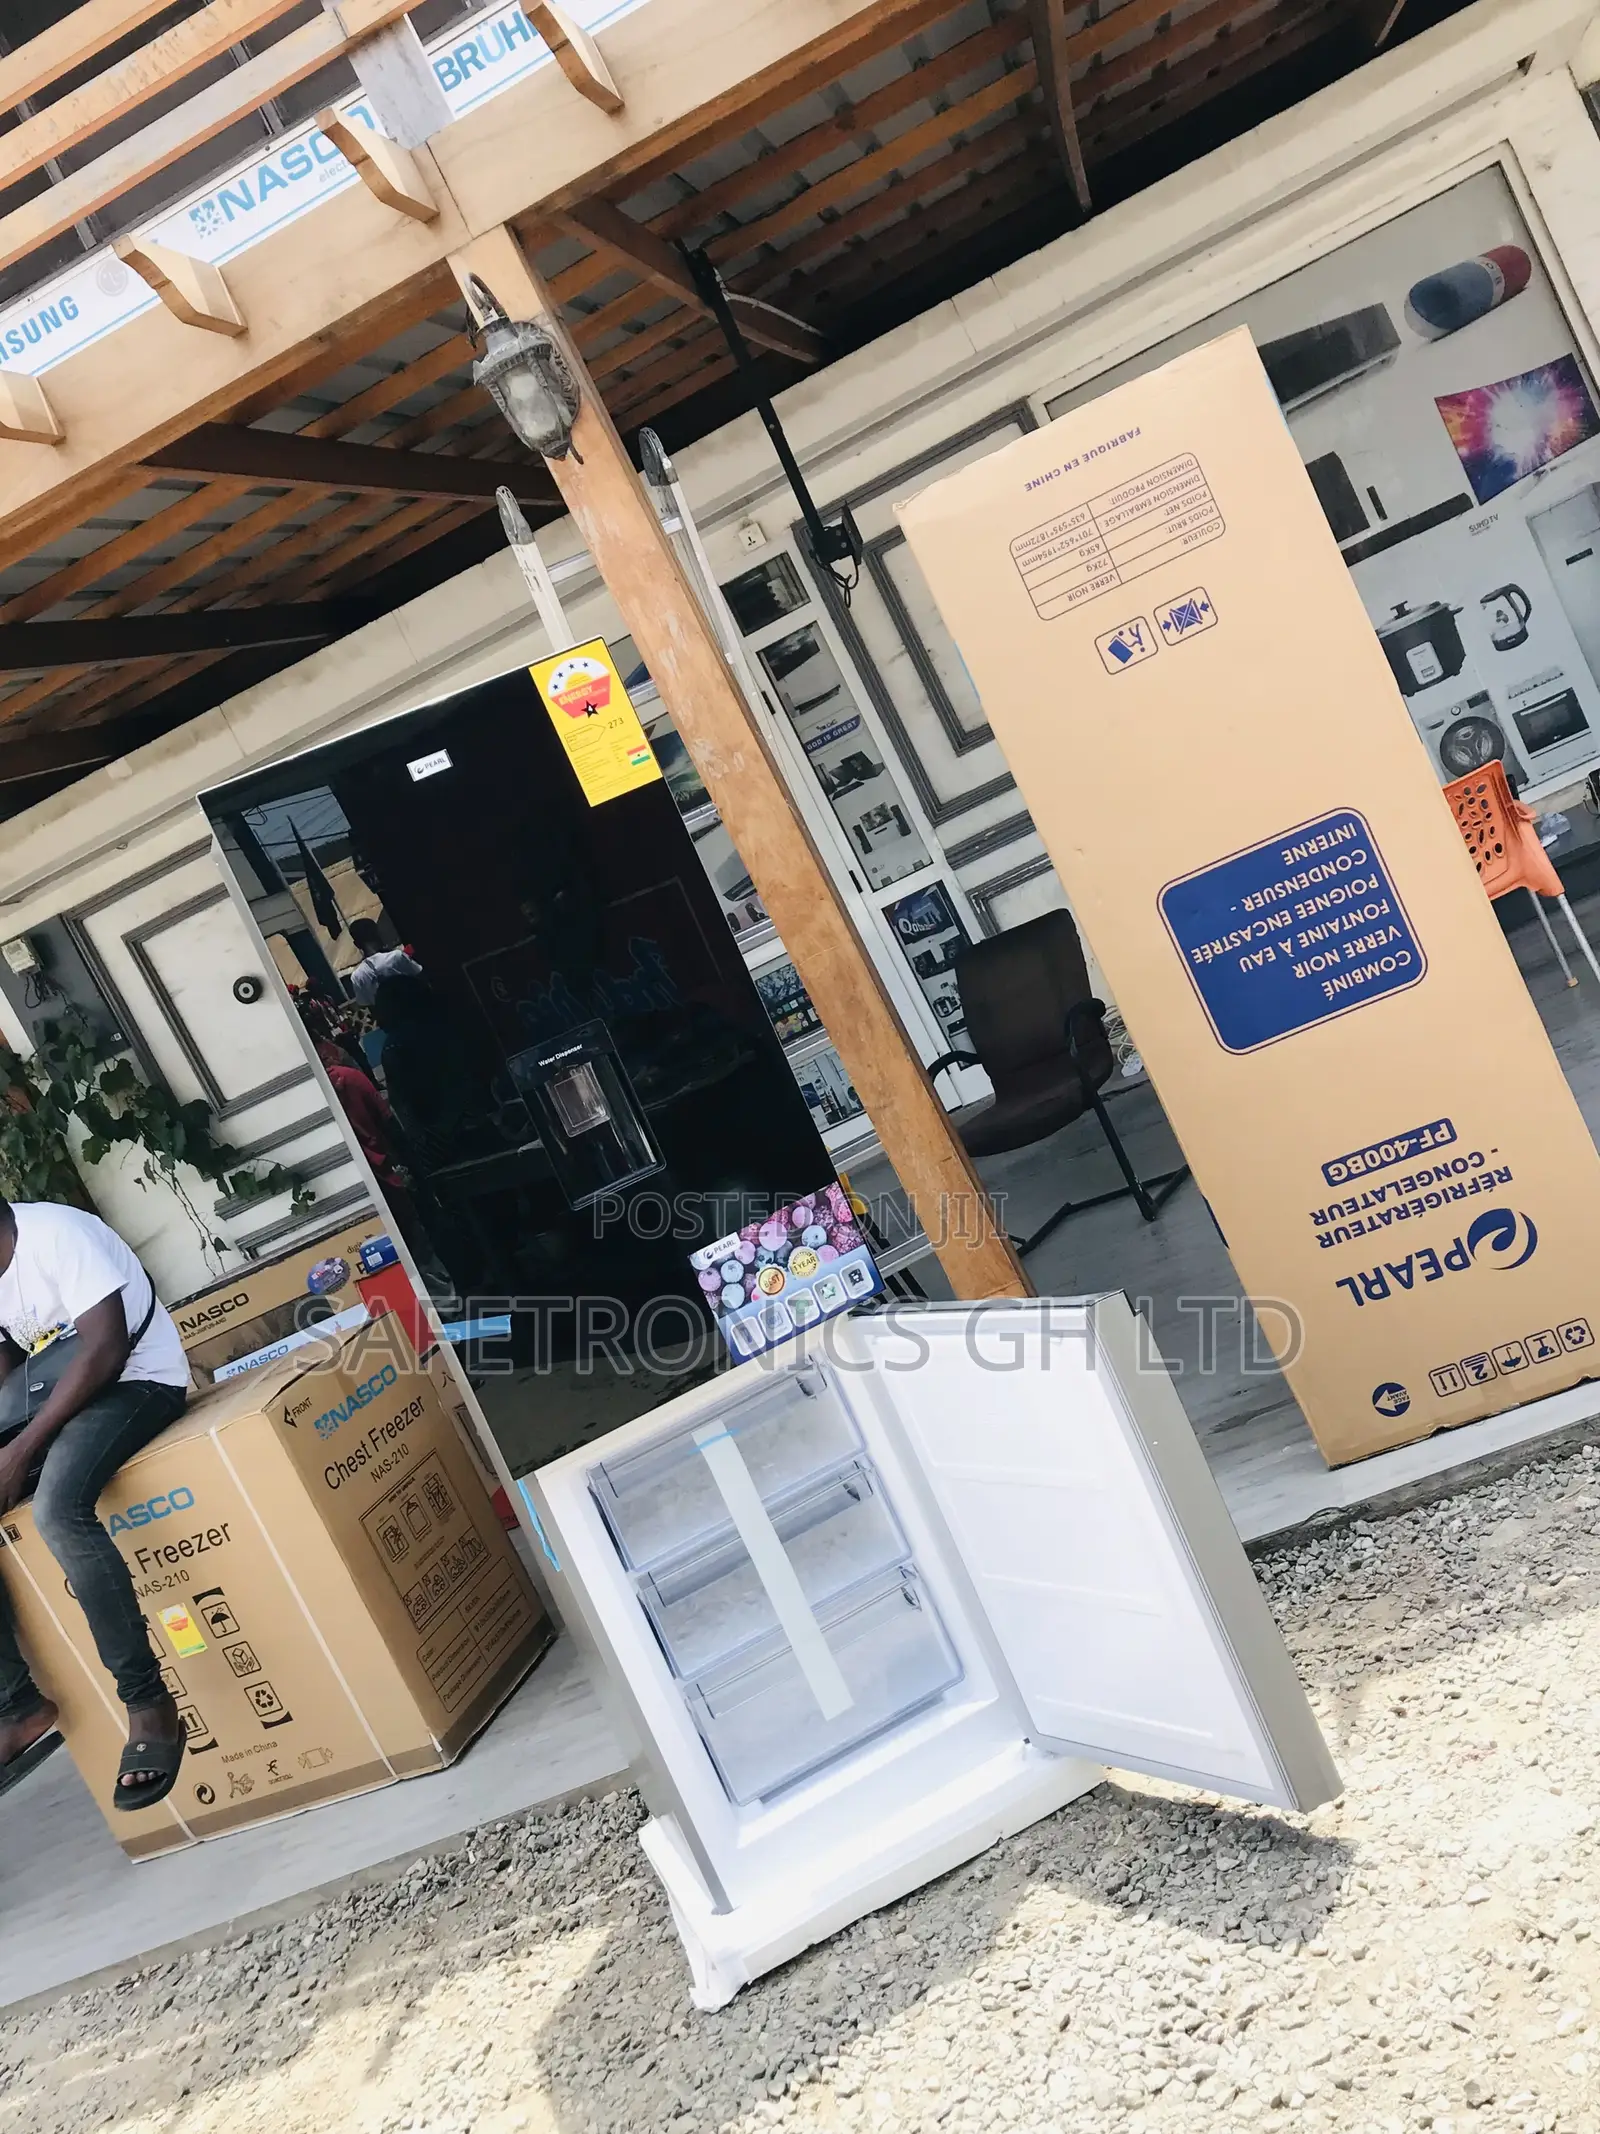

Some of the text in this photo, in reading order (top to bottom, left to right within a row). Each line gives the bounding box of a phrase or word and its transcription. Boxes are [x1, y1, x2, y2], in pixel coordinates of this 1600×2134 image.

[319, 161, 352, 183] elect
[1023, 427, 1141, 491] FABRIQUÉ EN CHINE
[1145, 458, 1193, 486] DIMENSION
[1152, 474, 1200, 501] DIMENSION
[1180, 490, 1207, 508] POIDS
[1103, 498, 1151, 526] EMBALLAGE
[1187, 505, 1214, 523] POIDS
[1488, 513, 1499, 522] TV
[1078, 543, 1100, 557] 65Kg
[1085, 558, 1107, 572] 72Kg
[1066, 573, 1115, 601] VERRE NOIR
[806, 738, 822, 750] GOD
[823, 733, 831, 741] IS
[832, 719, 857, 736] GREAT
[424, 757, 447, 769] PEARL
[1280, 821, 1357, 865] INTERNE
[1240, 846, 1368, 911] CONDENSUER
[1190, 872, 1379, 966] POIGNEE ENCASTRÉE
[1237, 897, 1390, 972] FONTAINE À EAU
[1291, 923, 1402, 978] VERRE NOIR
[1320, 948, 1412, 1000] COMBINÉ
[538, 1043, 583, 1067] Water Dispenser
[1325, 1122, 1451, 1182] PF-400BG
[1308, 1149, 1486, 1227] CONGELATEUR
[1314, 1164, 1514, 1249] RÉFRIGÉRATEUR
[713, 1238, 737, 1254] PEARL
[796, 1255, 815, 1269] YEAR
[1334, 1236, 1470, 1307] PEARL
[763, 1274, 780, 1287] BEST
[179, 1292, 250, 1333] NASCO
[238, 1345, 289, 1373] NASCO
[291, 1396, 313, 1418] FRONT
[328, 1363, 399, 1428] NASCO
[1386, 1390, 1407, 1401] AVANT
[1393, 1395, 1409, 1404] FACE
[321, 1395, 426, 1490] Chest Freezer
[369, 1443, 410, 1482] NAS-210
[108, 1484, 195, 1536] ASCO
[135, 1522, 233, 1574] Freezer
[221, 1739, 277, 1763] Made in China
